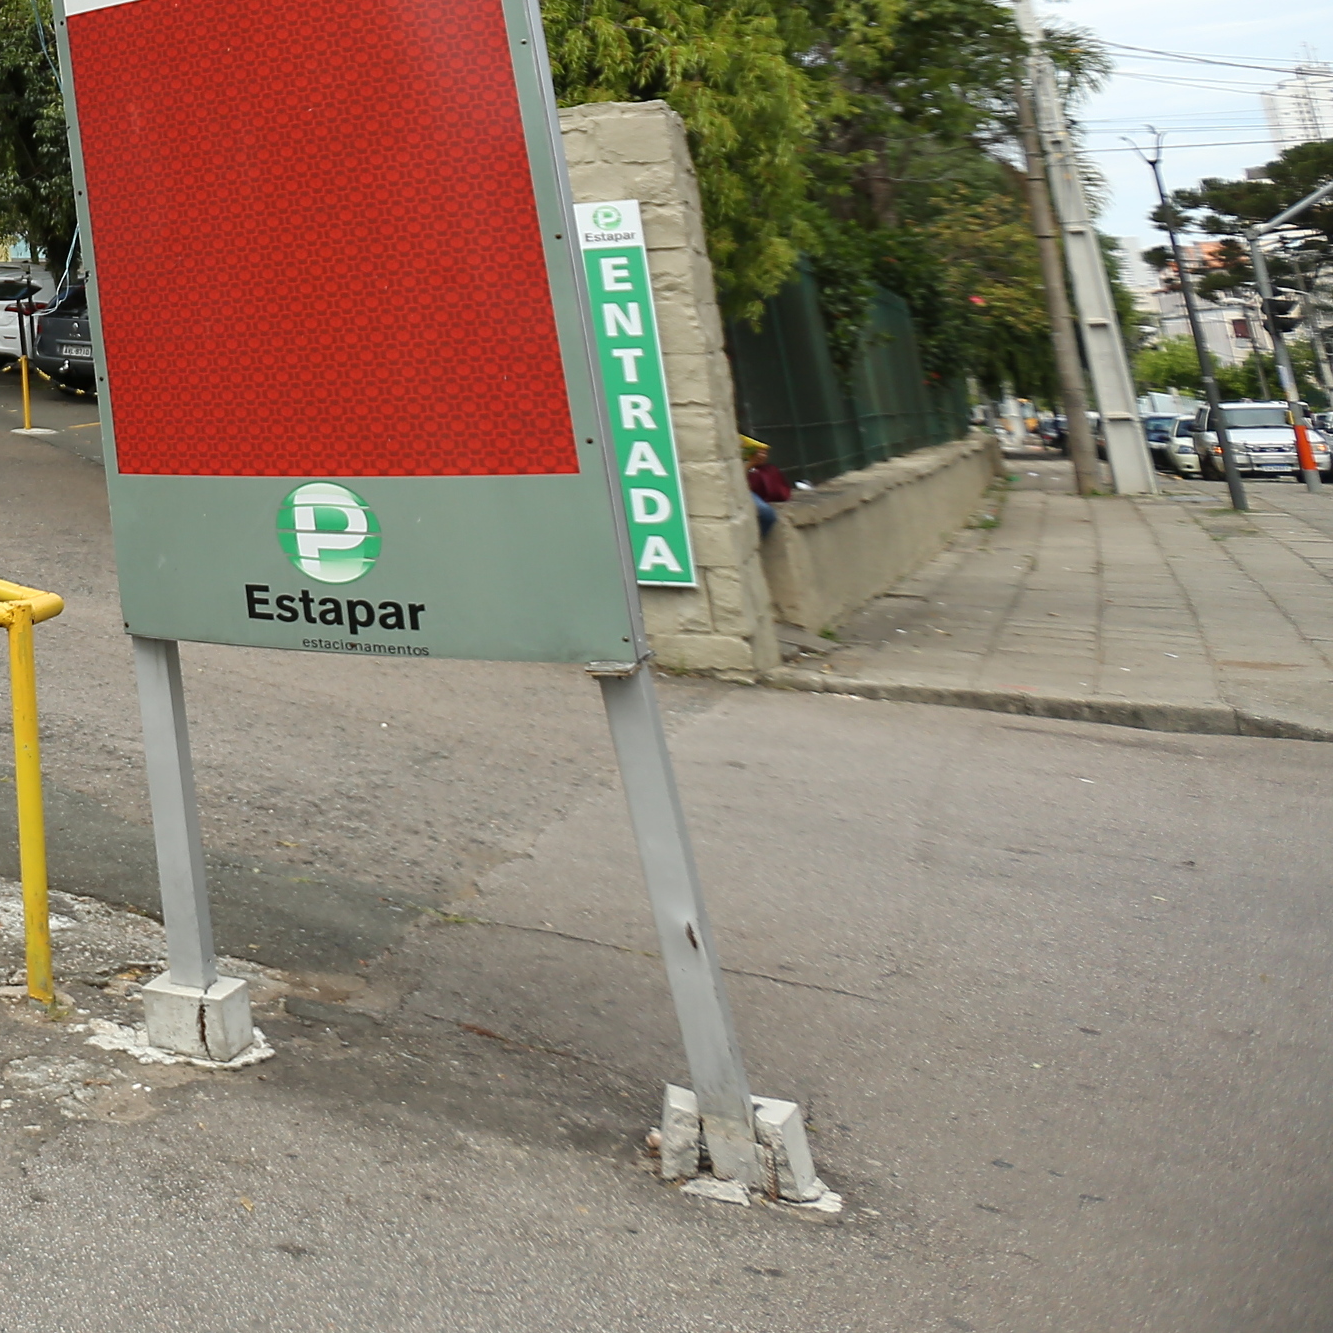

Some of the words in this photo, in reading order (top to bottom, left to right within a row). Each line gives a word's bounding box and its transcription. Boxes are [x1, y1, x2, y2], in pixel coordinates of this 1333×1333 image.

[584, 231, 636, 242] Estapar
[599, 256, 684, 574] ENTRADA
[244, 582, 427, 635] Estapar
[302, 638, 430, 656] estacionamentos
